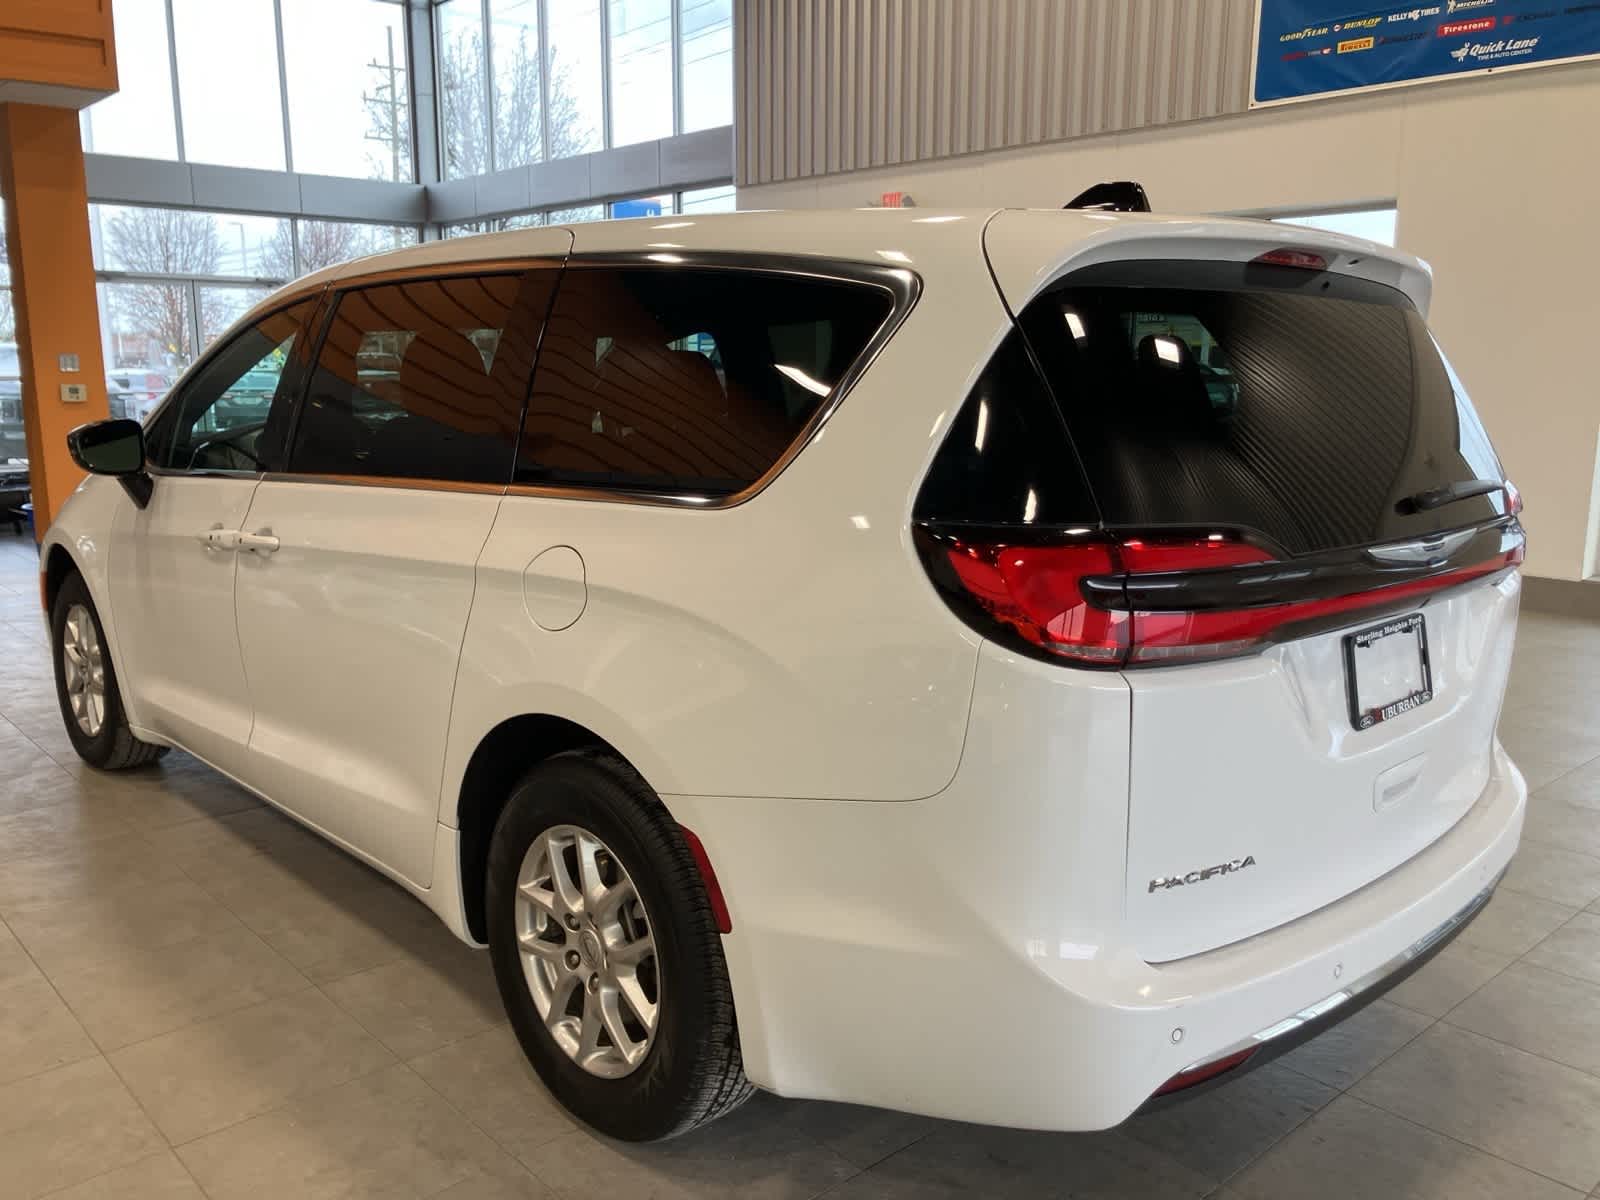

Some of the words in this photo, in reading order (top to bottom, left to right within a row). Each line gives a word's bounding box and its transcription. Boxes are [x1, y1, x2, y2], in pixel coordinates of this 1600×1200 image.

[1388, 12, 1408, 22] KELLY
[1421, 7, 1440, 16] TIRES
[1344, 17, 1382, 30] DUNLOP
[1443, 21, 1491, 35] Firestone
[1280, 27, 1329, 42] GOODYEAR
[1470, 40, 1506, 56] Quick
[1505, 38, 1539, 50] Lane
[1374, 694, 1420, 721] UBURBAN
[1148, 855, 1256, 893] PACIFICA
